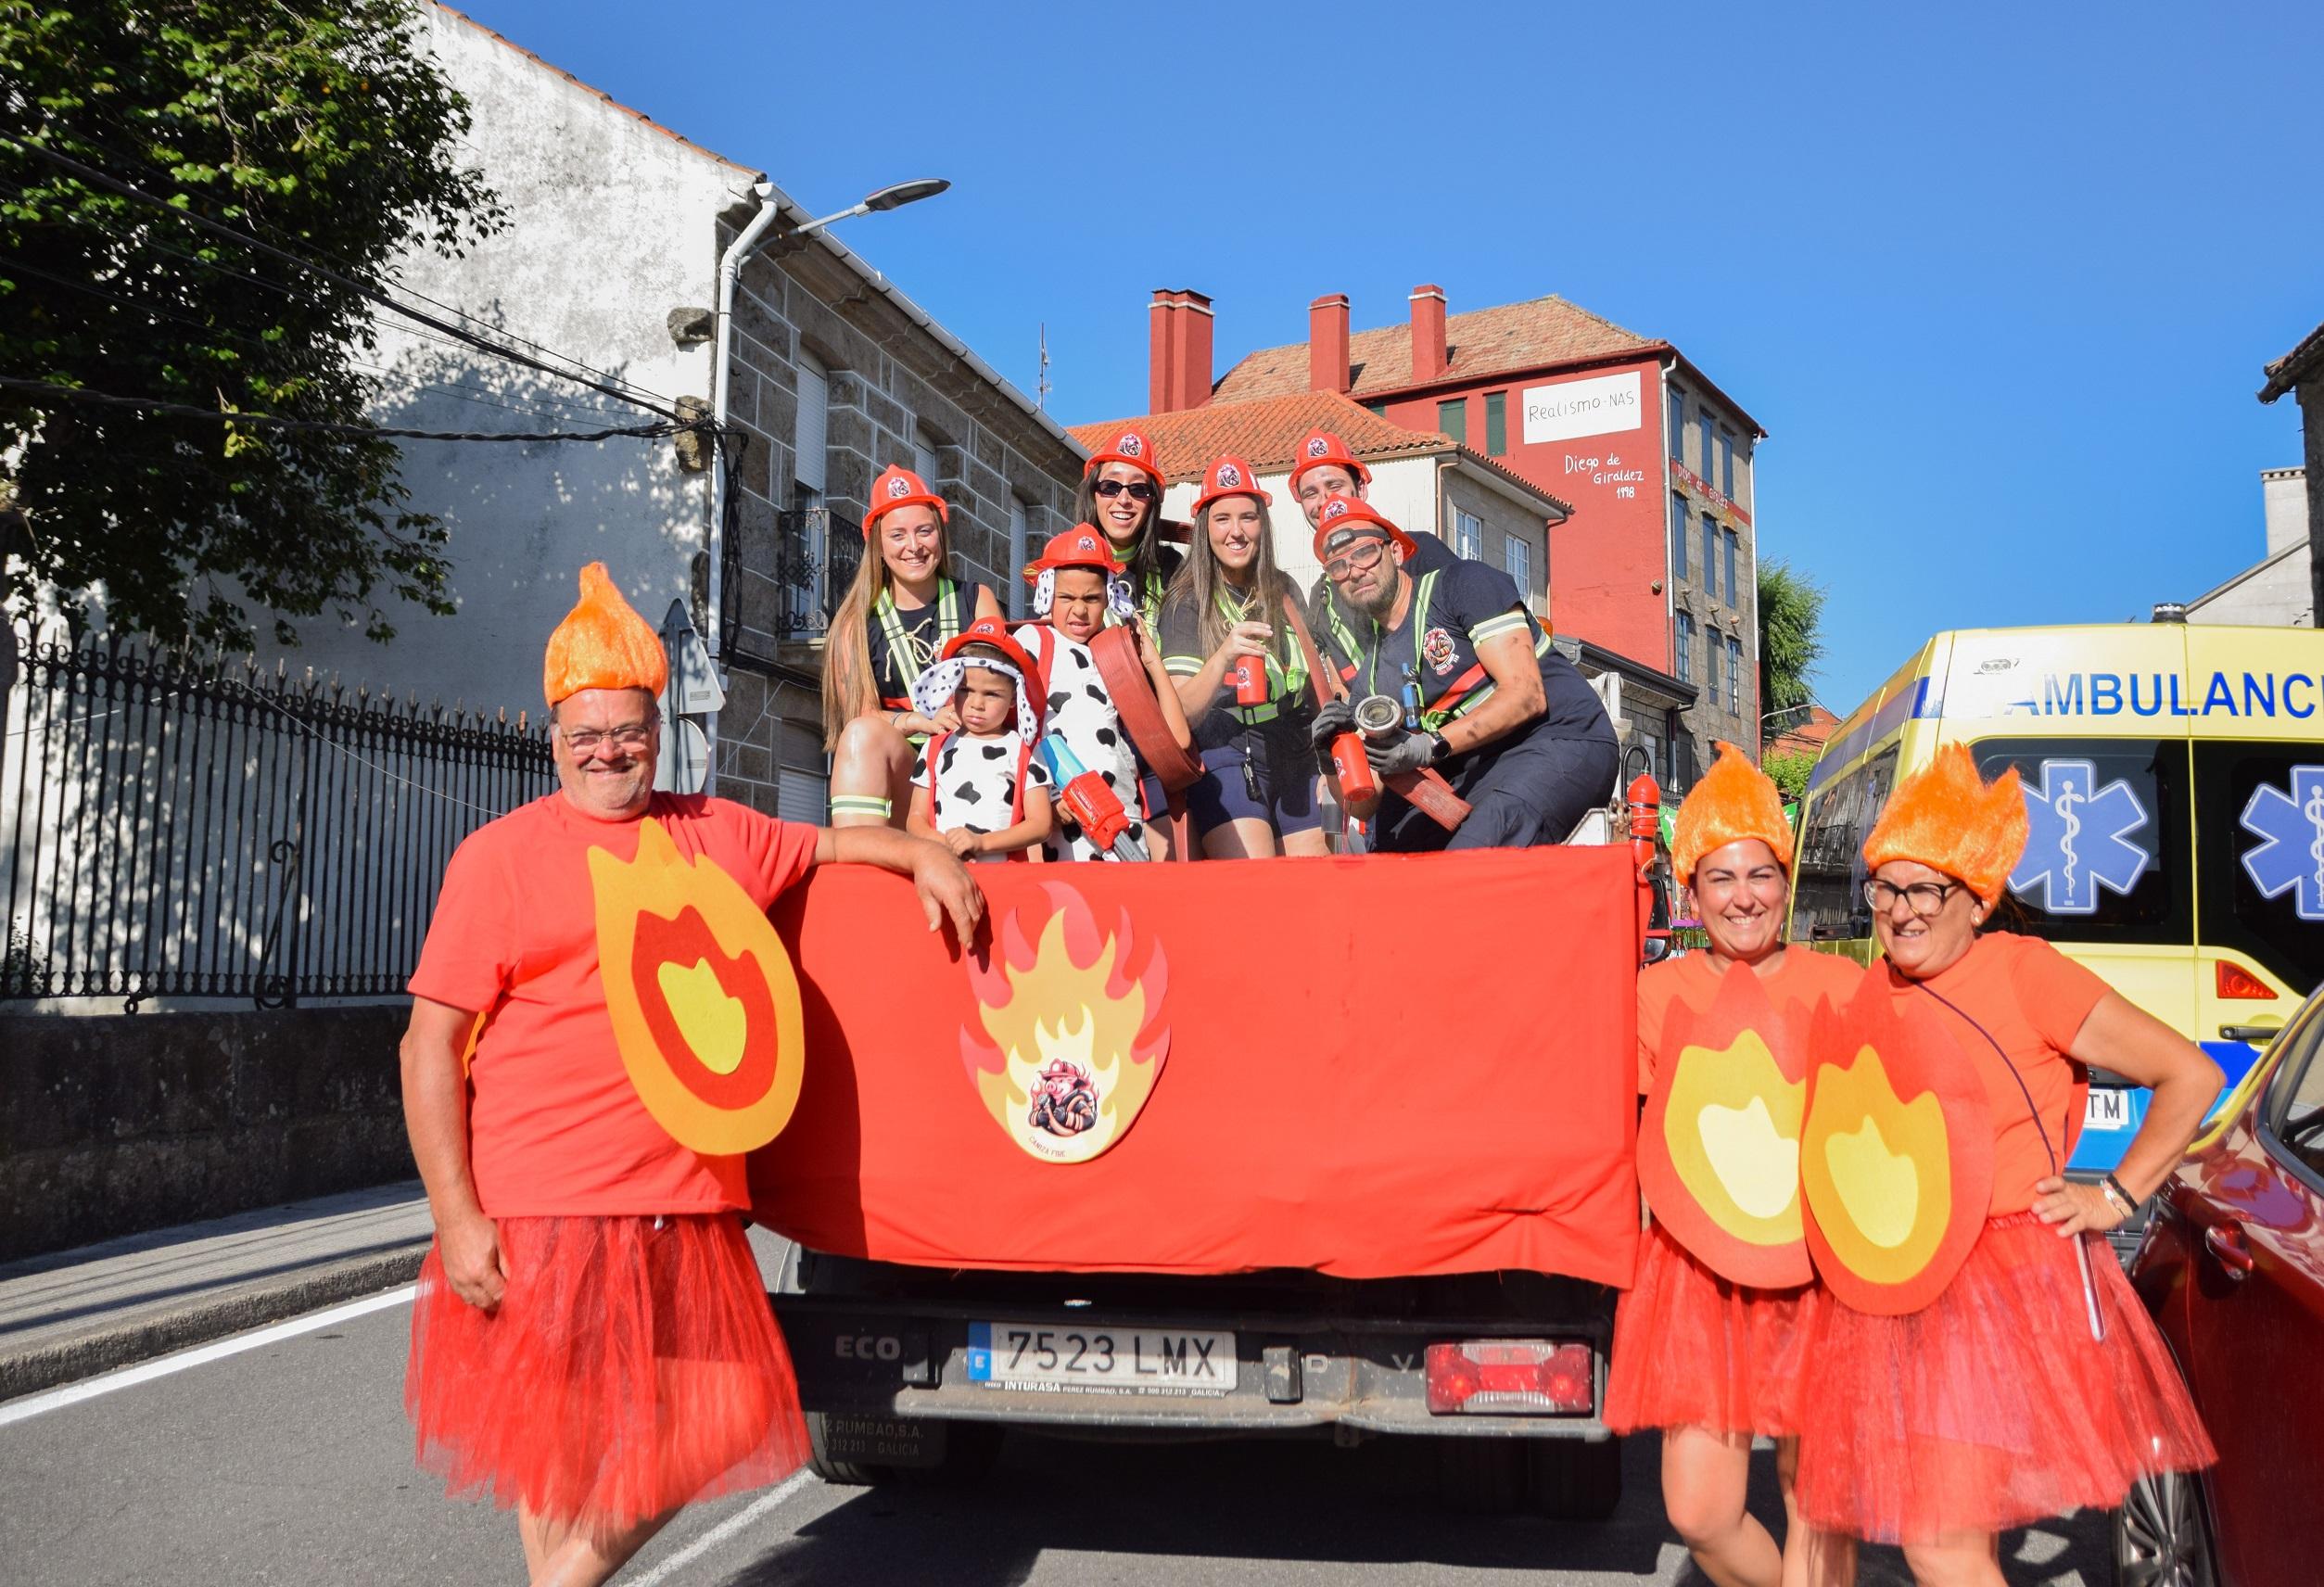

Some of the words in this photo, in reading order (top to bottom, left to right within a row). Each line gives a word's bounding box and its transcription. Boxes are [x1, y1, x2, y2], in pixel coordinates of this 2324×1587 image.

[1565, 454, 1599, 475] Diego
[1606, 452, 1621, 466] de
[1616, 486, 1635, 499] 1998
[2003, 672, 2324, 718] AMBULANC
[835, 1336, 901, 1361] ECO
[975, 1356, 984, 1369] E
[1008, 1331, 1115, 1374] 7523
[1135, 1335, 1215, 1378] LMX
[1004, 1380, 1060, 1392] INTURASA
[1191, 1389, 1220, 1397] GALICIA
[878, 1441, 920, 1457] GALICIA
